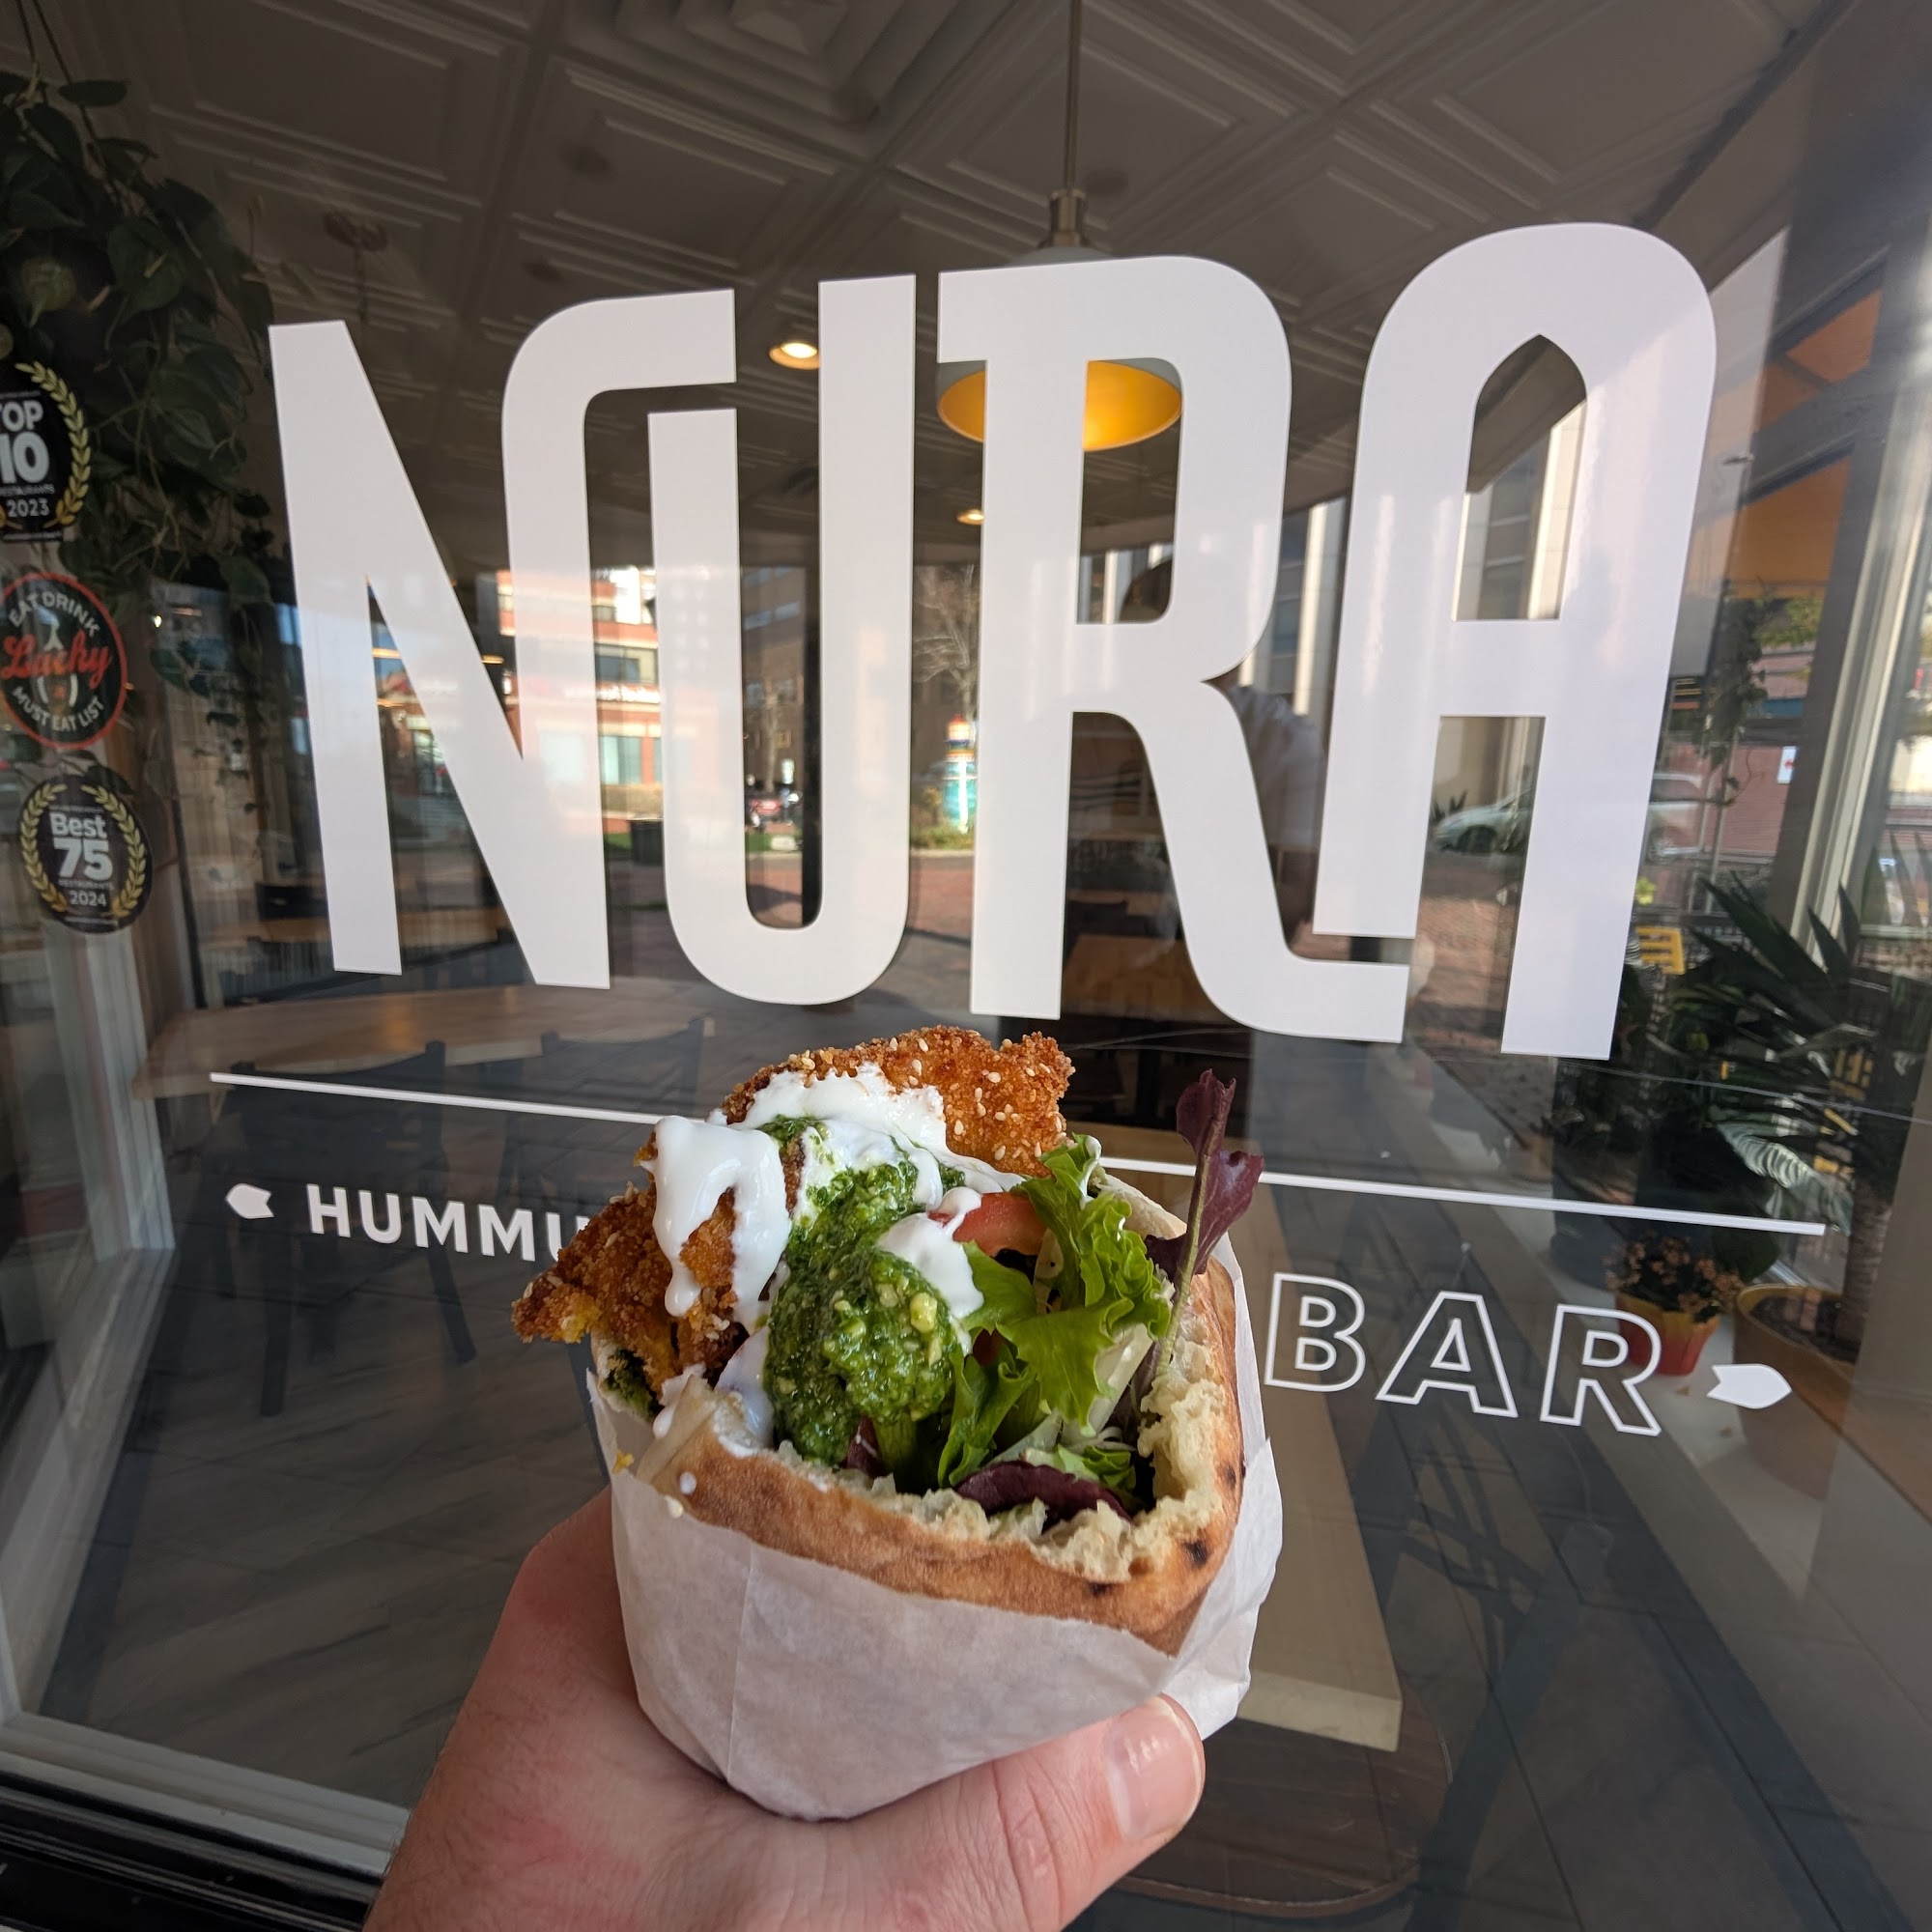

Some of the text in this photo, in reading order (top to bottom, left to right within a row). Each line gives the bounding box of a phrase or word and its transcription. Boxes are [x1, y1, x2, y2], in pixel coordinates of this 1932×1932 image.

[0, 400, 43, 432] OP
[0, 431, 49, 483] 10
[7, 497, 50, 517] 2023
[42, 591, 100, 638] DRINK
[269, 223, 1717, 1060] NURA
[13, 686, 104, 732] MUST EAT LIST
[49, 811, 108, 839] Best
[53, 837, 114, 881] 75
[70, 890, 107, 907] 2024
[306, 1183, 1662, 1436] HUMMU BAR
